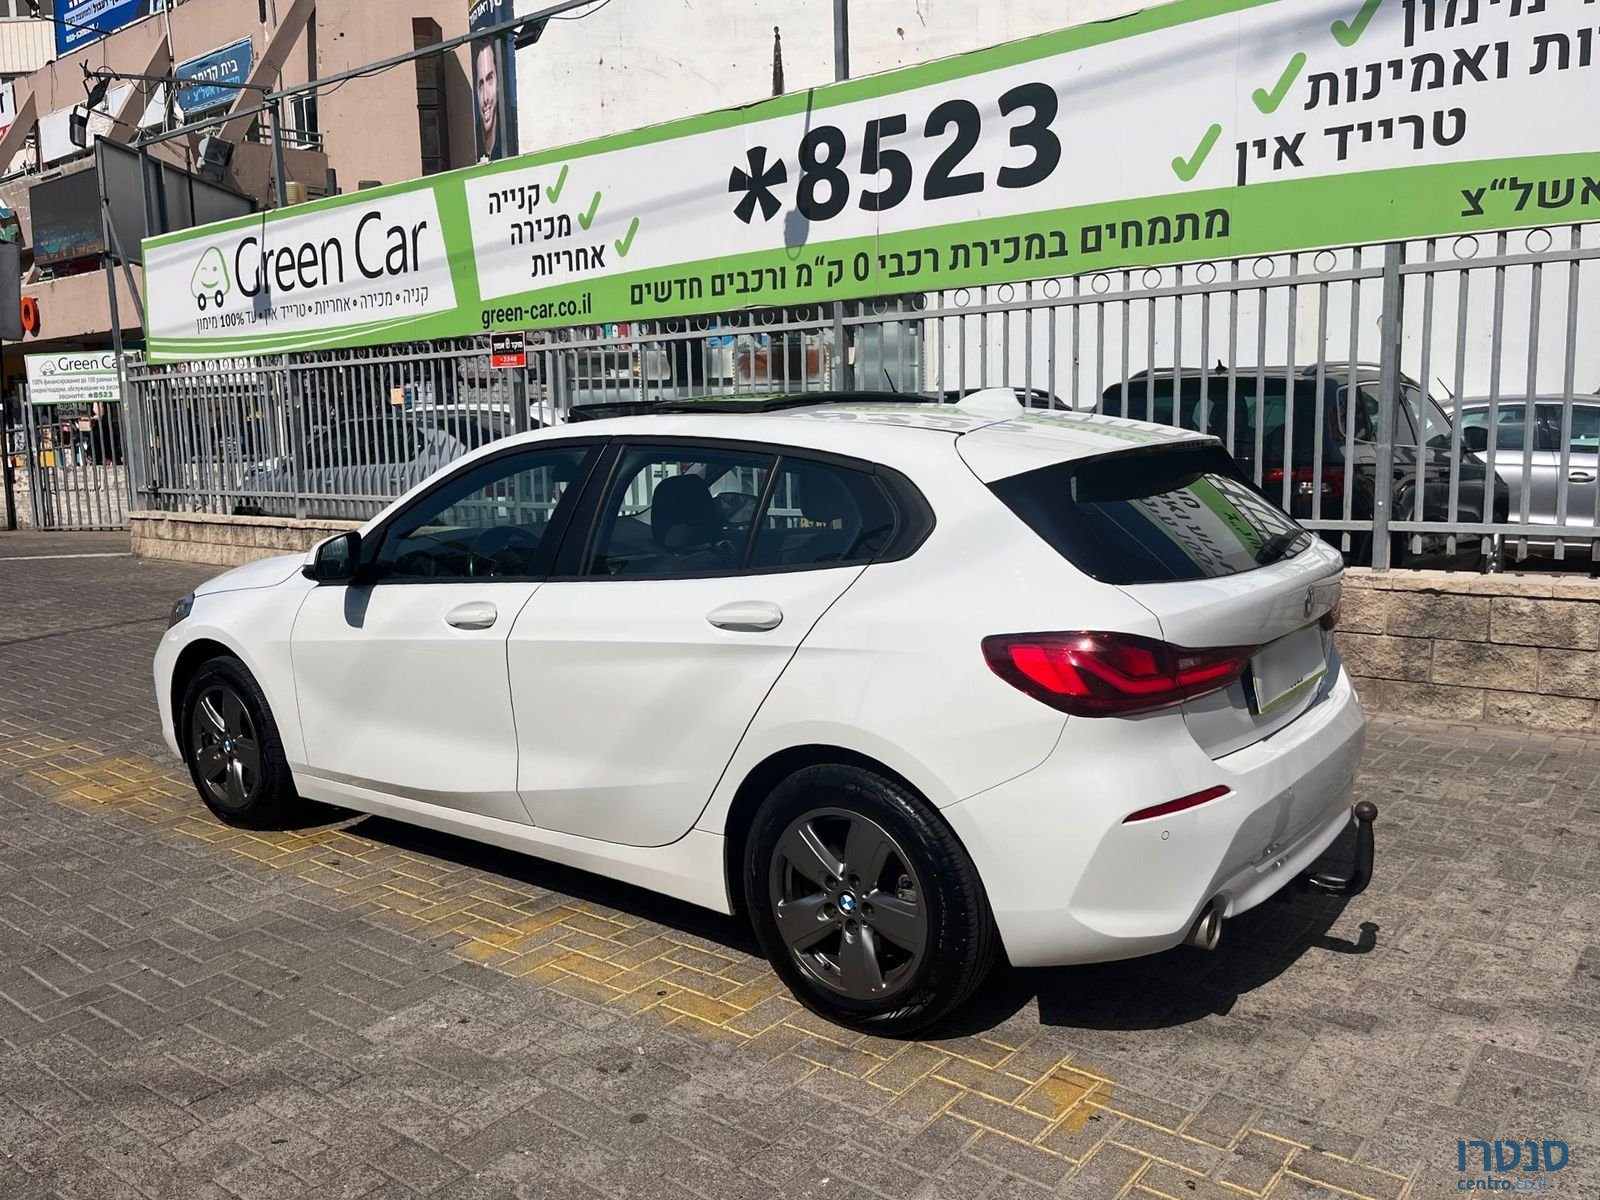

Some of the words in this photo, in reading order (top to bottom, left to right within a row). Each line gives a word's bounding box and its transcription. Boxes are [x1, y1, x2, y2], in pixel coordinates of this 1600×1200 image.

[1402, 0, 1546, 48] מון
[221, 60, 238, 76] בית
[1304, 41, 1509, 111] ואמינות
[1324, 107, 1467, 161] טרייד
[1235, 131, 1306, 187] אין
[489, 184, 541, 215] קנייה
[510, 213, 572, 245] מכירה
[1081, 207, 1230, 254] מתמחים
[235, 236, 344, 298] Green
[355, 211, 428, 279] Car
[531, 244, 606, 277] אחריות
[878, 247, 940, 279] רכבי
[949, 229, 1069, 270] במכירת
[711, 266, 786, 297] ורכבים
[853, 251, 869, 282] 0
[315, 297, 351, 316] אחריות
[360, 291, 393, 310] מכירה
[403, 286, 429, 304] קניה
[630, 276, 703, 306] חדשים
[196, 315, 218, 335] מימון
[220, 311, 245, 328] 100%
[246, 310, 257, 325] עד
[263, 306, 277, 326] אין
[280, 303, 306, 320] טרייד
[481, 293, 592, 330] green-car.co.il
[58, 357, 99, 371] Green
[102, 355, 118, 369] Ca
